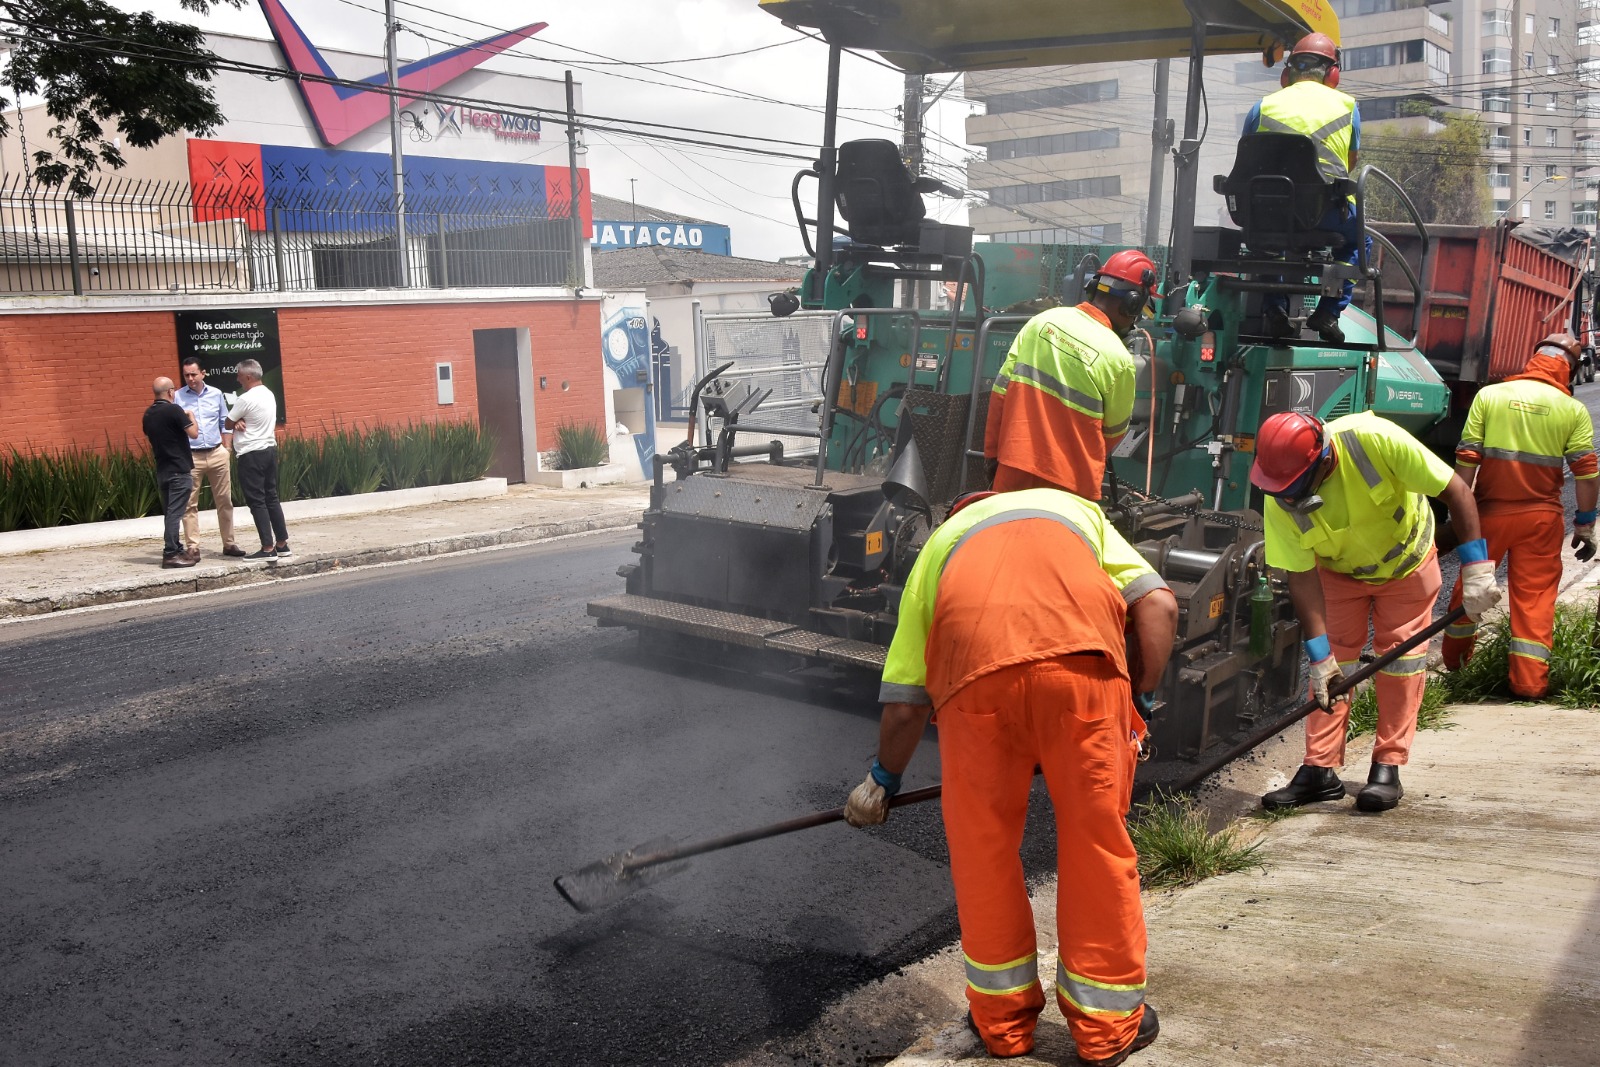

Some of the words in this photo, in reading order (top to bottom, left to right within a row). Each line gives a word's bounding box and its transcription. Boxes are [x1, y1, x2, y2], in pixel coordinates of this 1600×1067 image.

[461, 104, 540, 132] Headword
[195, 321, 212, 330] Nós
[214, 320, 251, 329] cuidamos
[630, 317, 645, 329] 406
[190, 331, 208, 340] você
[211, 330, 245, 341] aproveita
[247, 329, 264, 339] todo
[200, 343, 221, 351] amor
[230, 336, 262, 350] carinho
[210, 367, 220, 376] (11)
